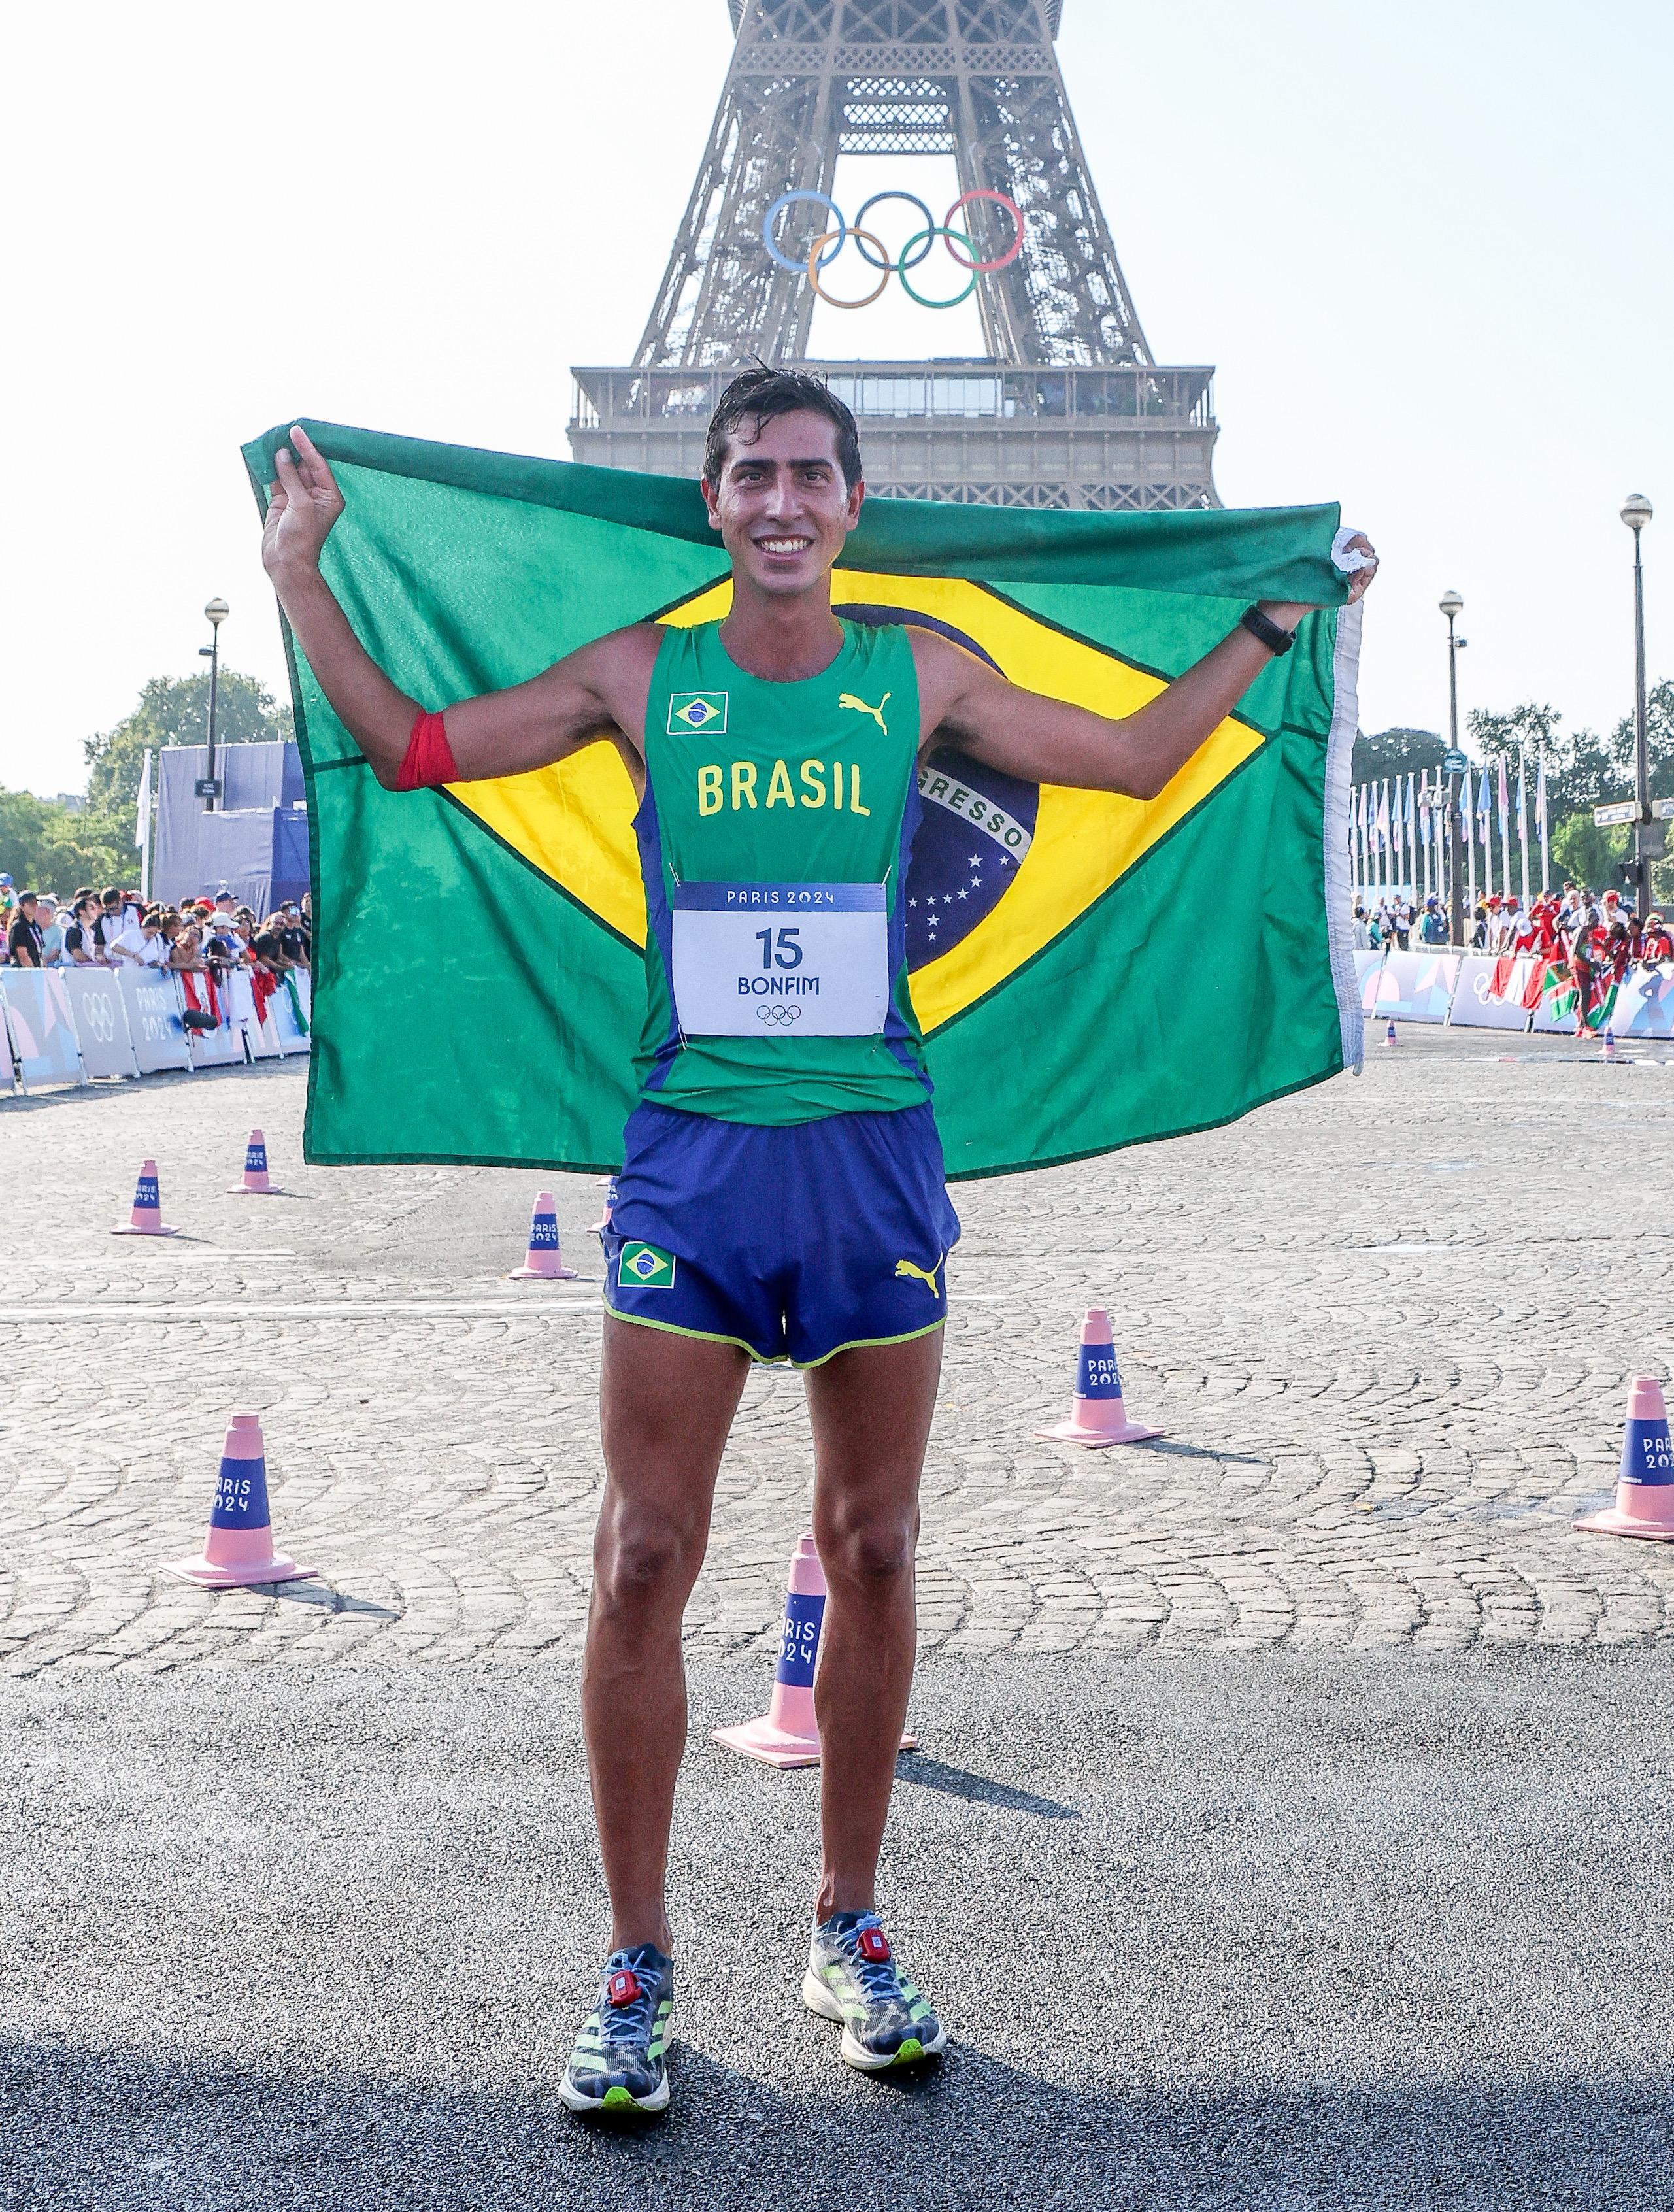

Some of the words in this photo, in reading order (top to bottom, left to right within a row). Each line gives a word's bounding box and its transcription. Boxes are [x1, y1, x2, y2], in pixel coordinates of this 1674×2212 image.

[697, 759, 871, 817] BRASIL
[787, 891, 834, 903] 2024
[756, 928, 803, 969] 15
[738, 977, 820, 996] BONFIM
